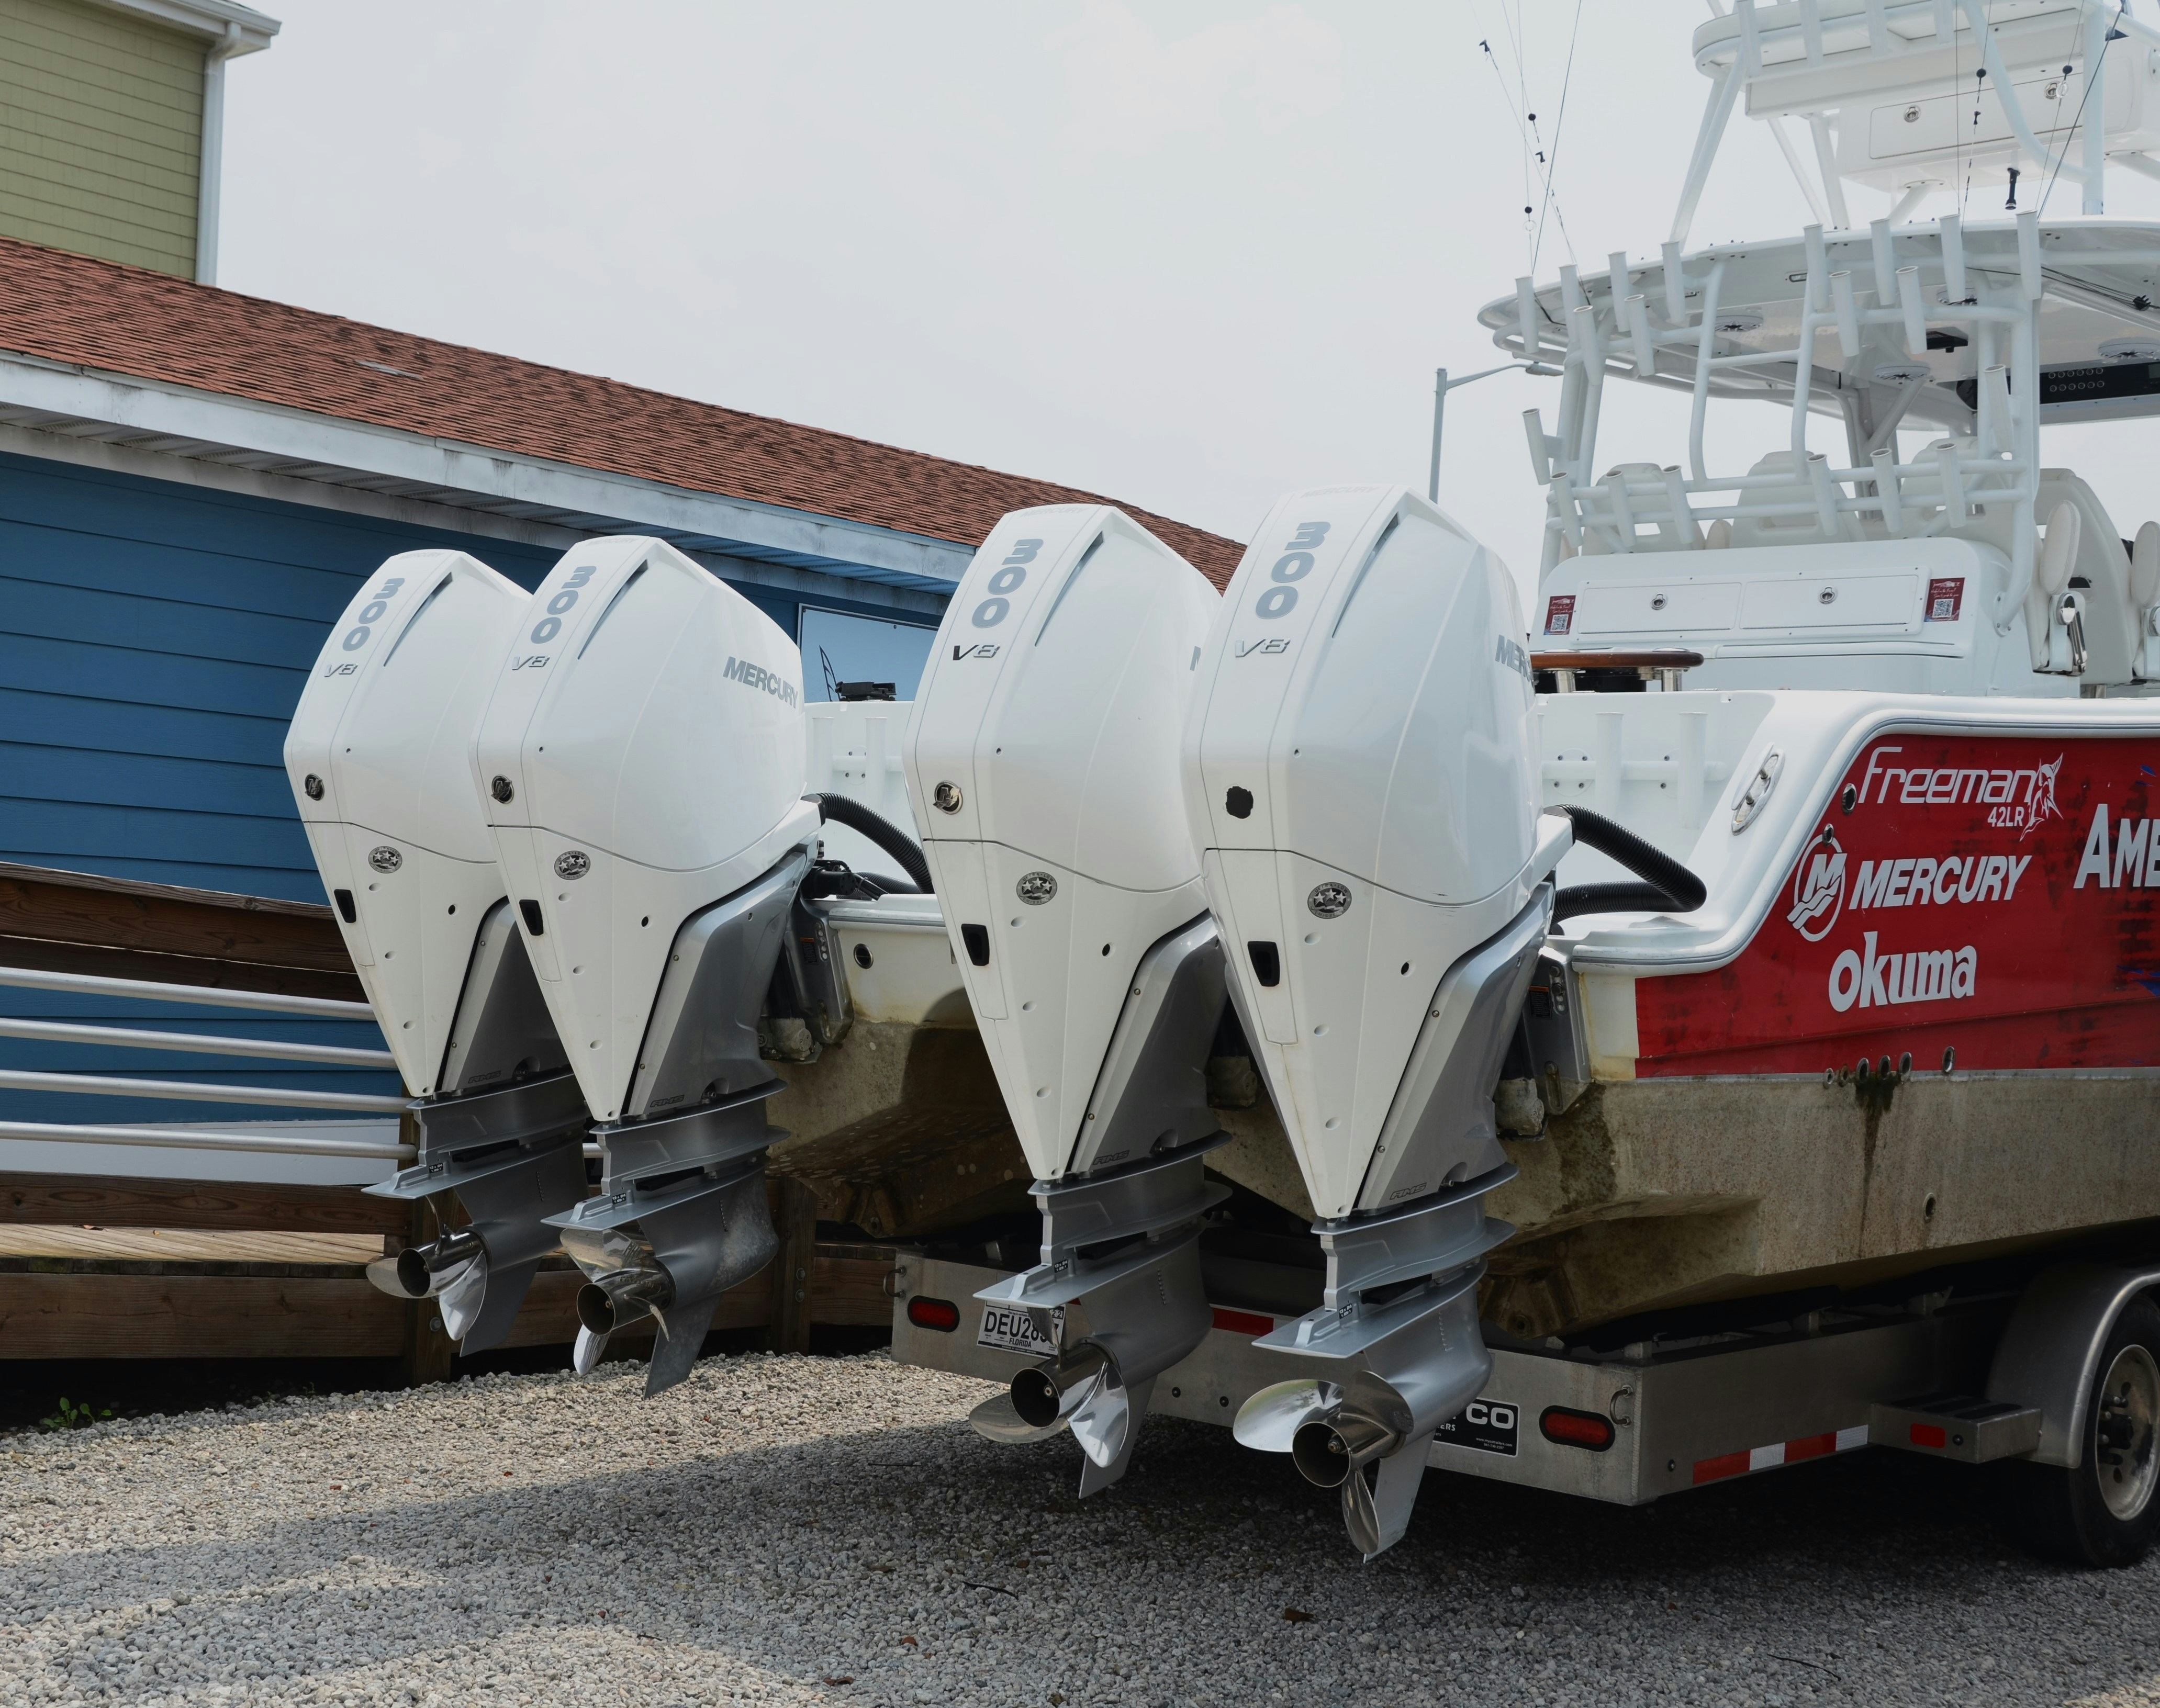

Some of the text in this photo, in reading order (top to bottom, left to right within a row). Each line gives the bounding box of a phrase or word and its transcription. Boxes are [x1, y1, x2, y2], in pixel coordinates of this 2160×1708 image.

[971, 538, 1044, 628] 300
[1256, 521, 1331, 620] 300
[342, 578, 405, 651] 300
[531, 566, 597, 644] 300
[953, 644, 1001, 660] V8
[1235, 638, 1291, 657] V8
[324, 663, 359, 677] V8
[511, 655, 551, 670] V8
[723, 656, 798, 709] MERCURY
[1857, 746, 2038, 803] Freeman
[1987, 806, 2024, 827] 42LR
[1849, 855, 2032, 909] MERCURY
[1092, 1150, 1130, 1165] AMS
[1389, 1182, 1427, 1200] AMS
[984, 1311, 1059, 1343] DEU28
[1009, 1338, 1032, 1348] FLORIDA
[1466, 1403, 1514, 1429] CO
